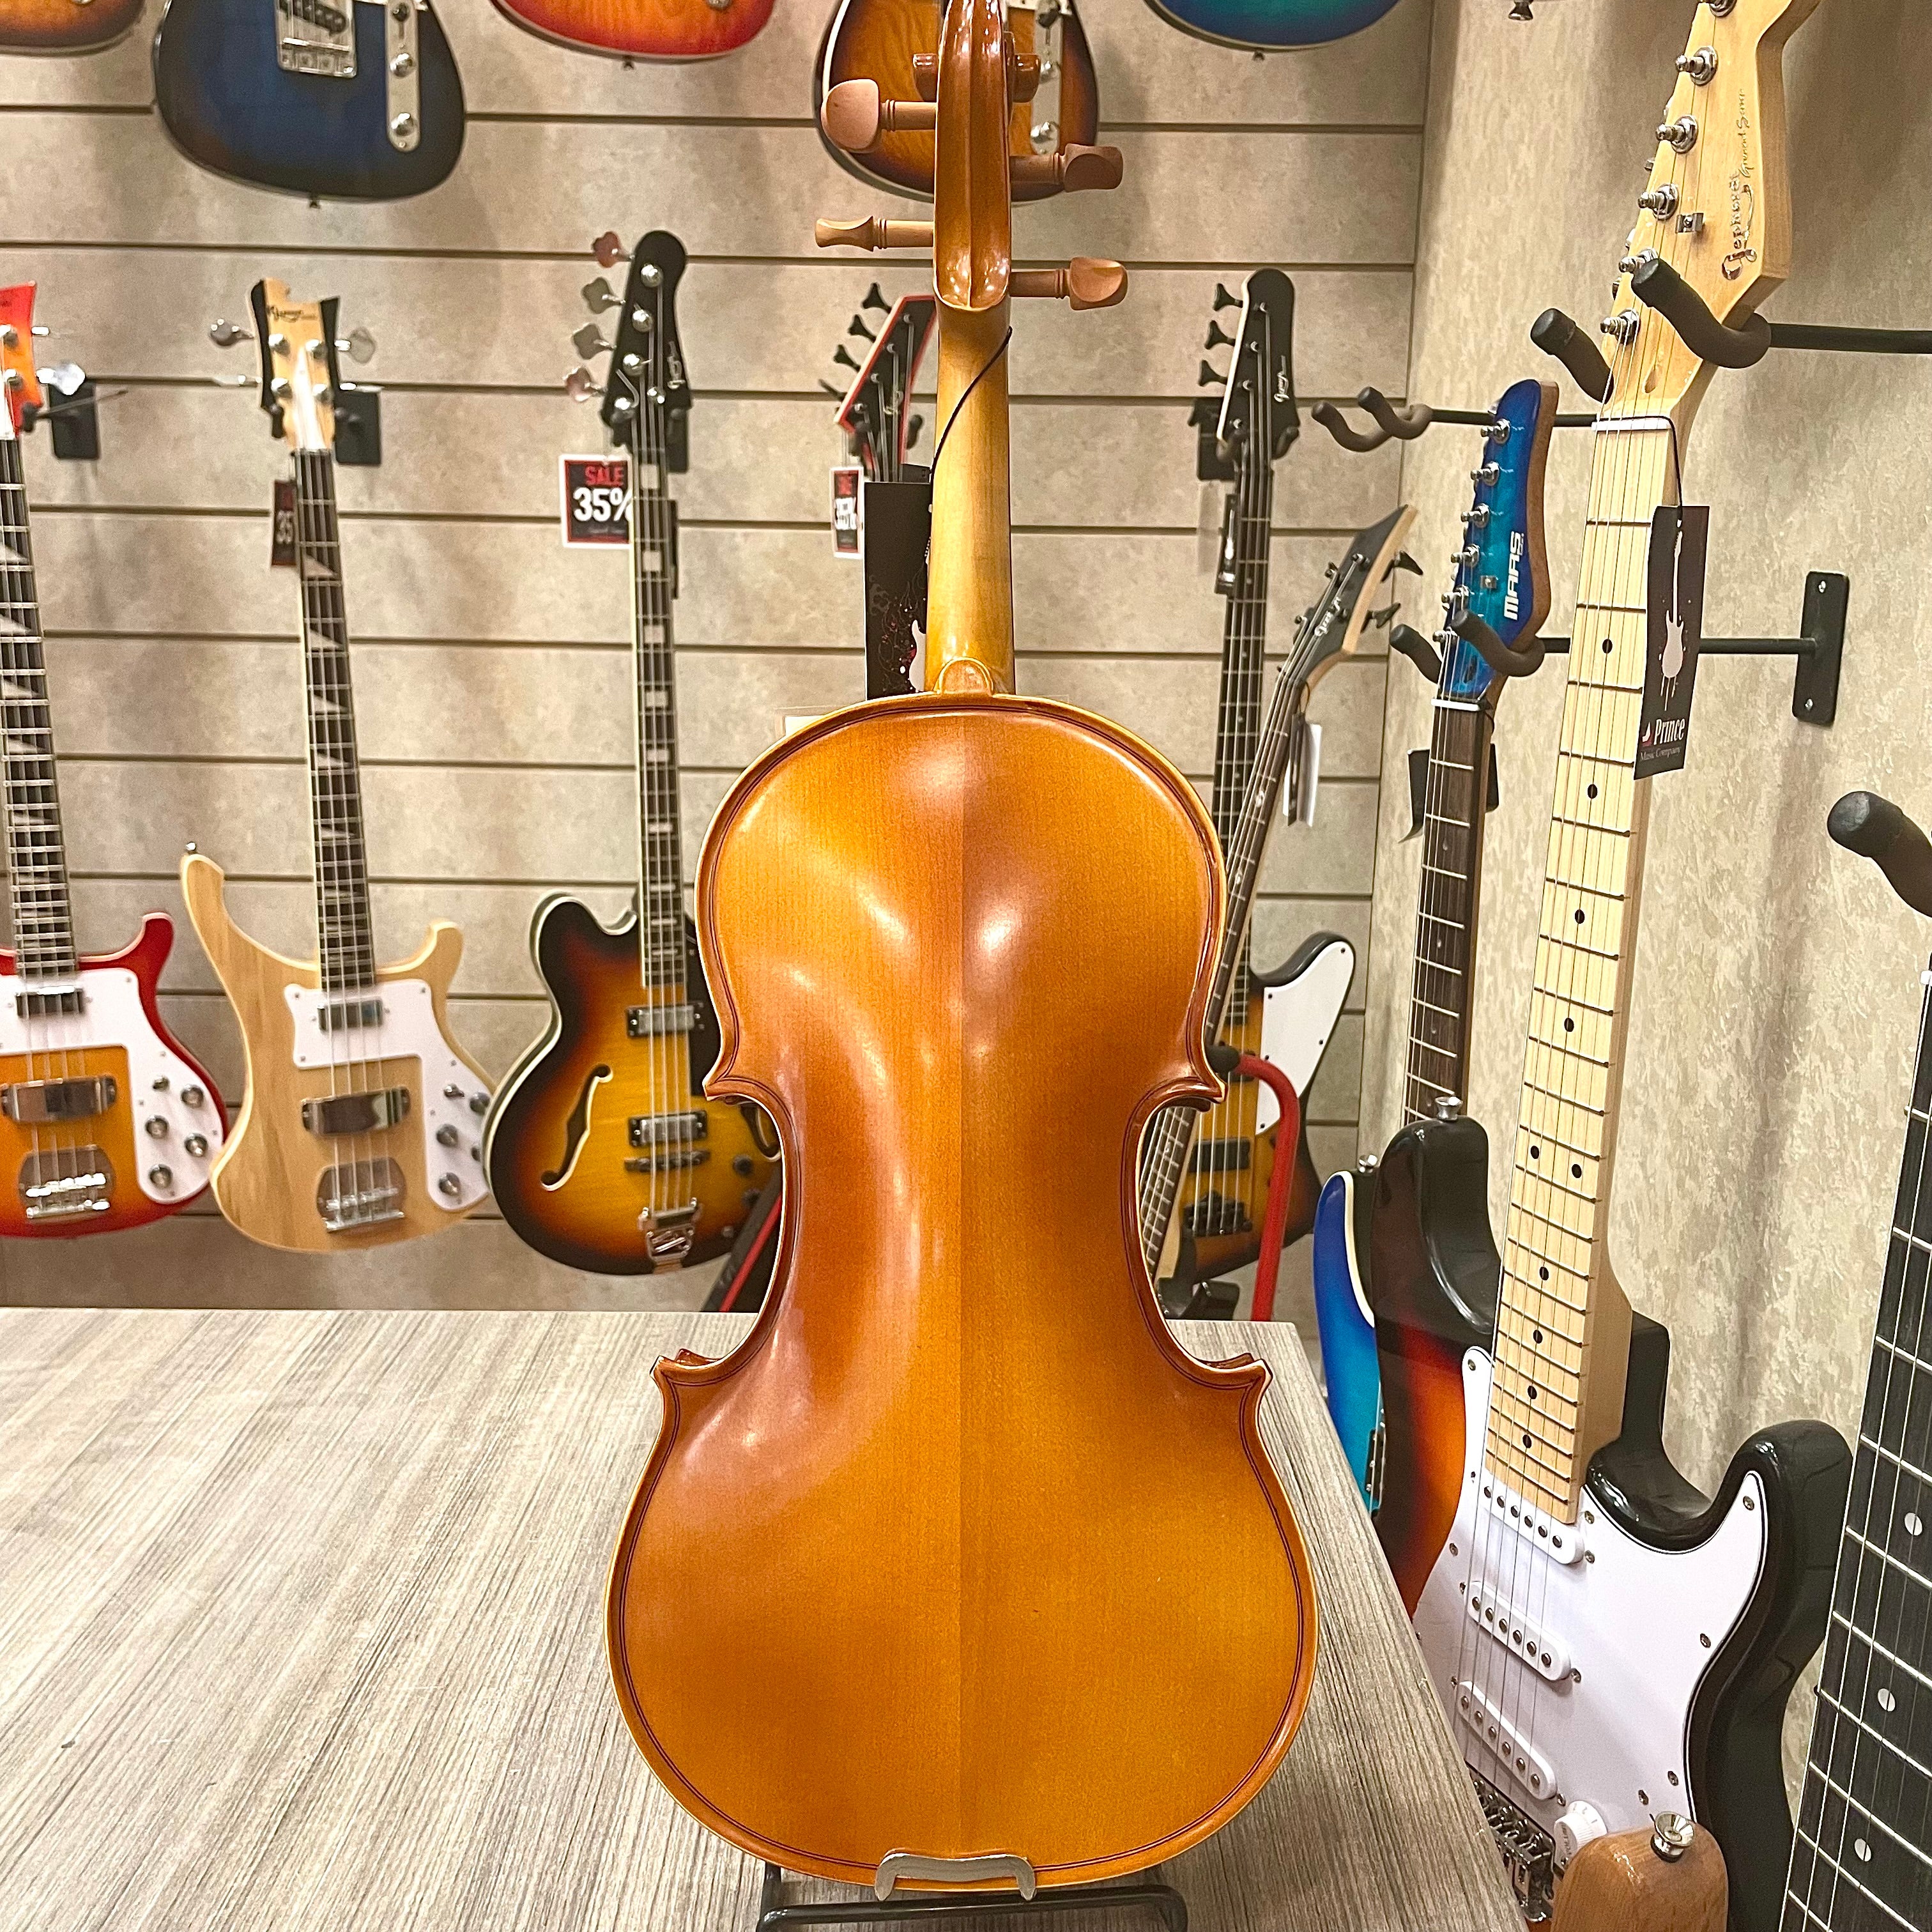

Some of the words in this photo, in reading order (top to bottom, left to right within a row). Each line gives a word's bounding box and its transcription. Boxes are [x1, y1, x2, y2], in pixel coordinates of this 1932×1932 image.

[585, 466, 624, 486] SALE
[573, 487, 632, 522] 35%
[1653, 718, 1685, 746] Prince
